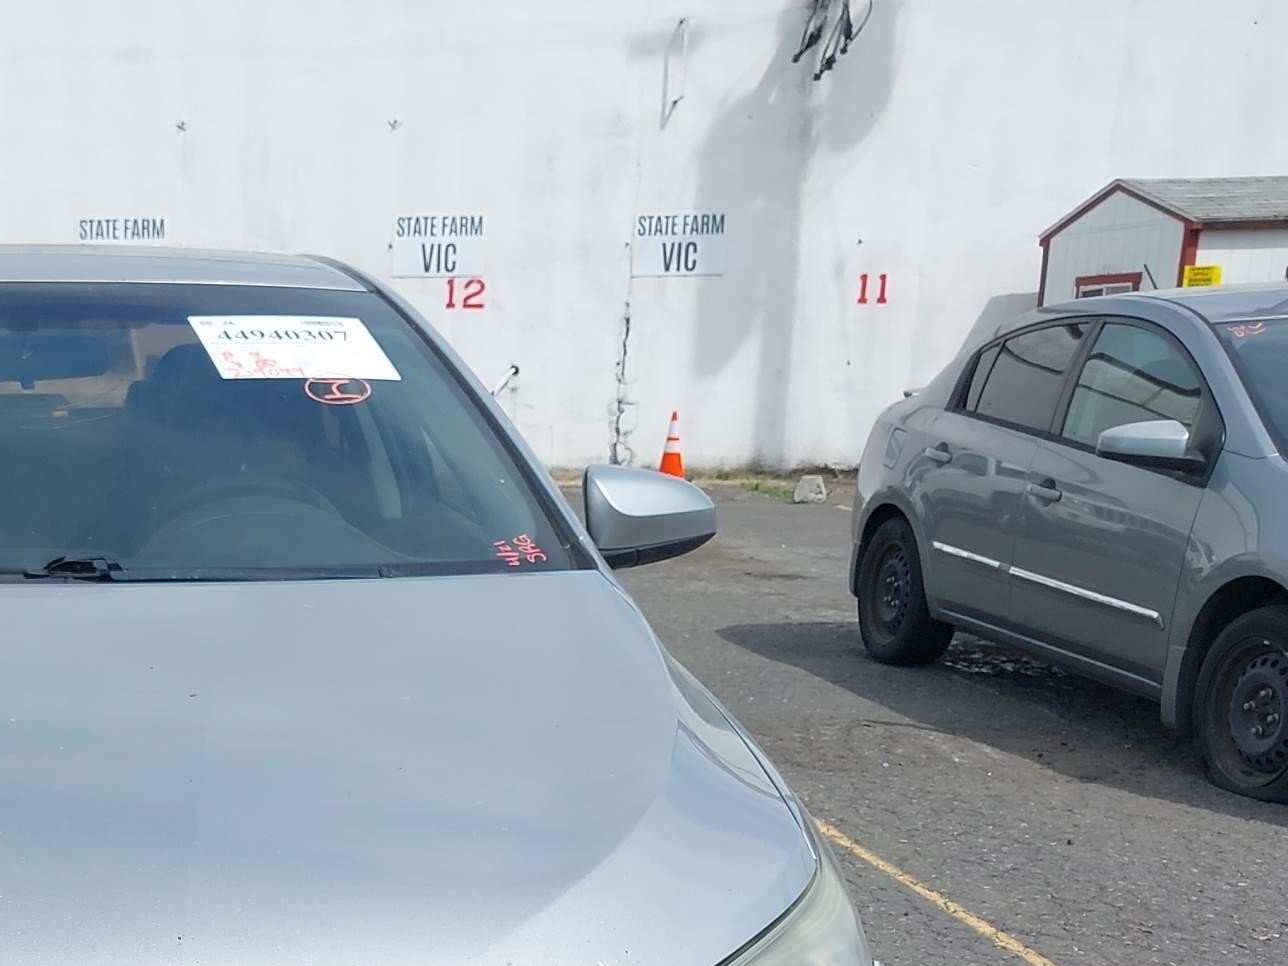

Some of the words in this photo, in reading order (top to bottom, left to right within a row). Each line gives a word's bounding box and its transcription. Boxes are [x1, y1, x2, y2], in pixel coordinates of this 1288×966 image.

[79, 219, 119, 240] STATE
[124, 218, 165, 239] FARM
[397, 216, 437, 238] STATE
[441, 215, 483, 237] FARM
[638, 215, 679, 237] STATE
[682, 213, 725, 236] FARM
[421, 243, 457, 273] VIC
[662, 242, 698, 273] VIC
[445, 278, 486, 309] 12
[857, 274, 889, 304] 11
[217, 329, 348, 342] 44940307
